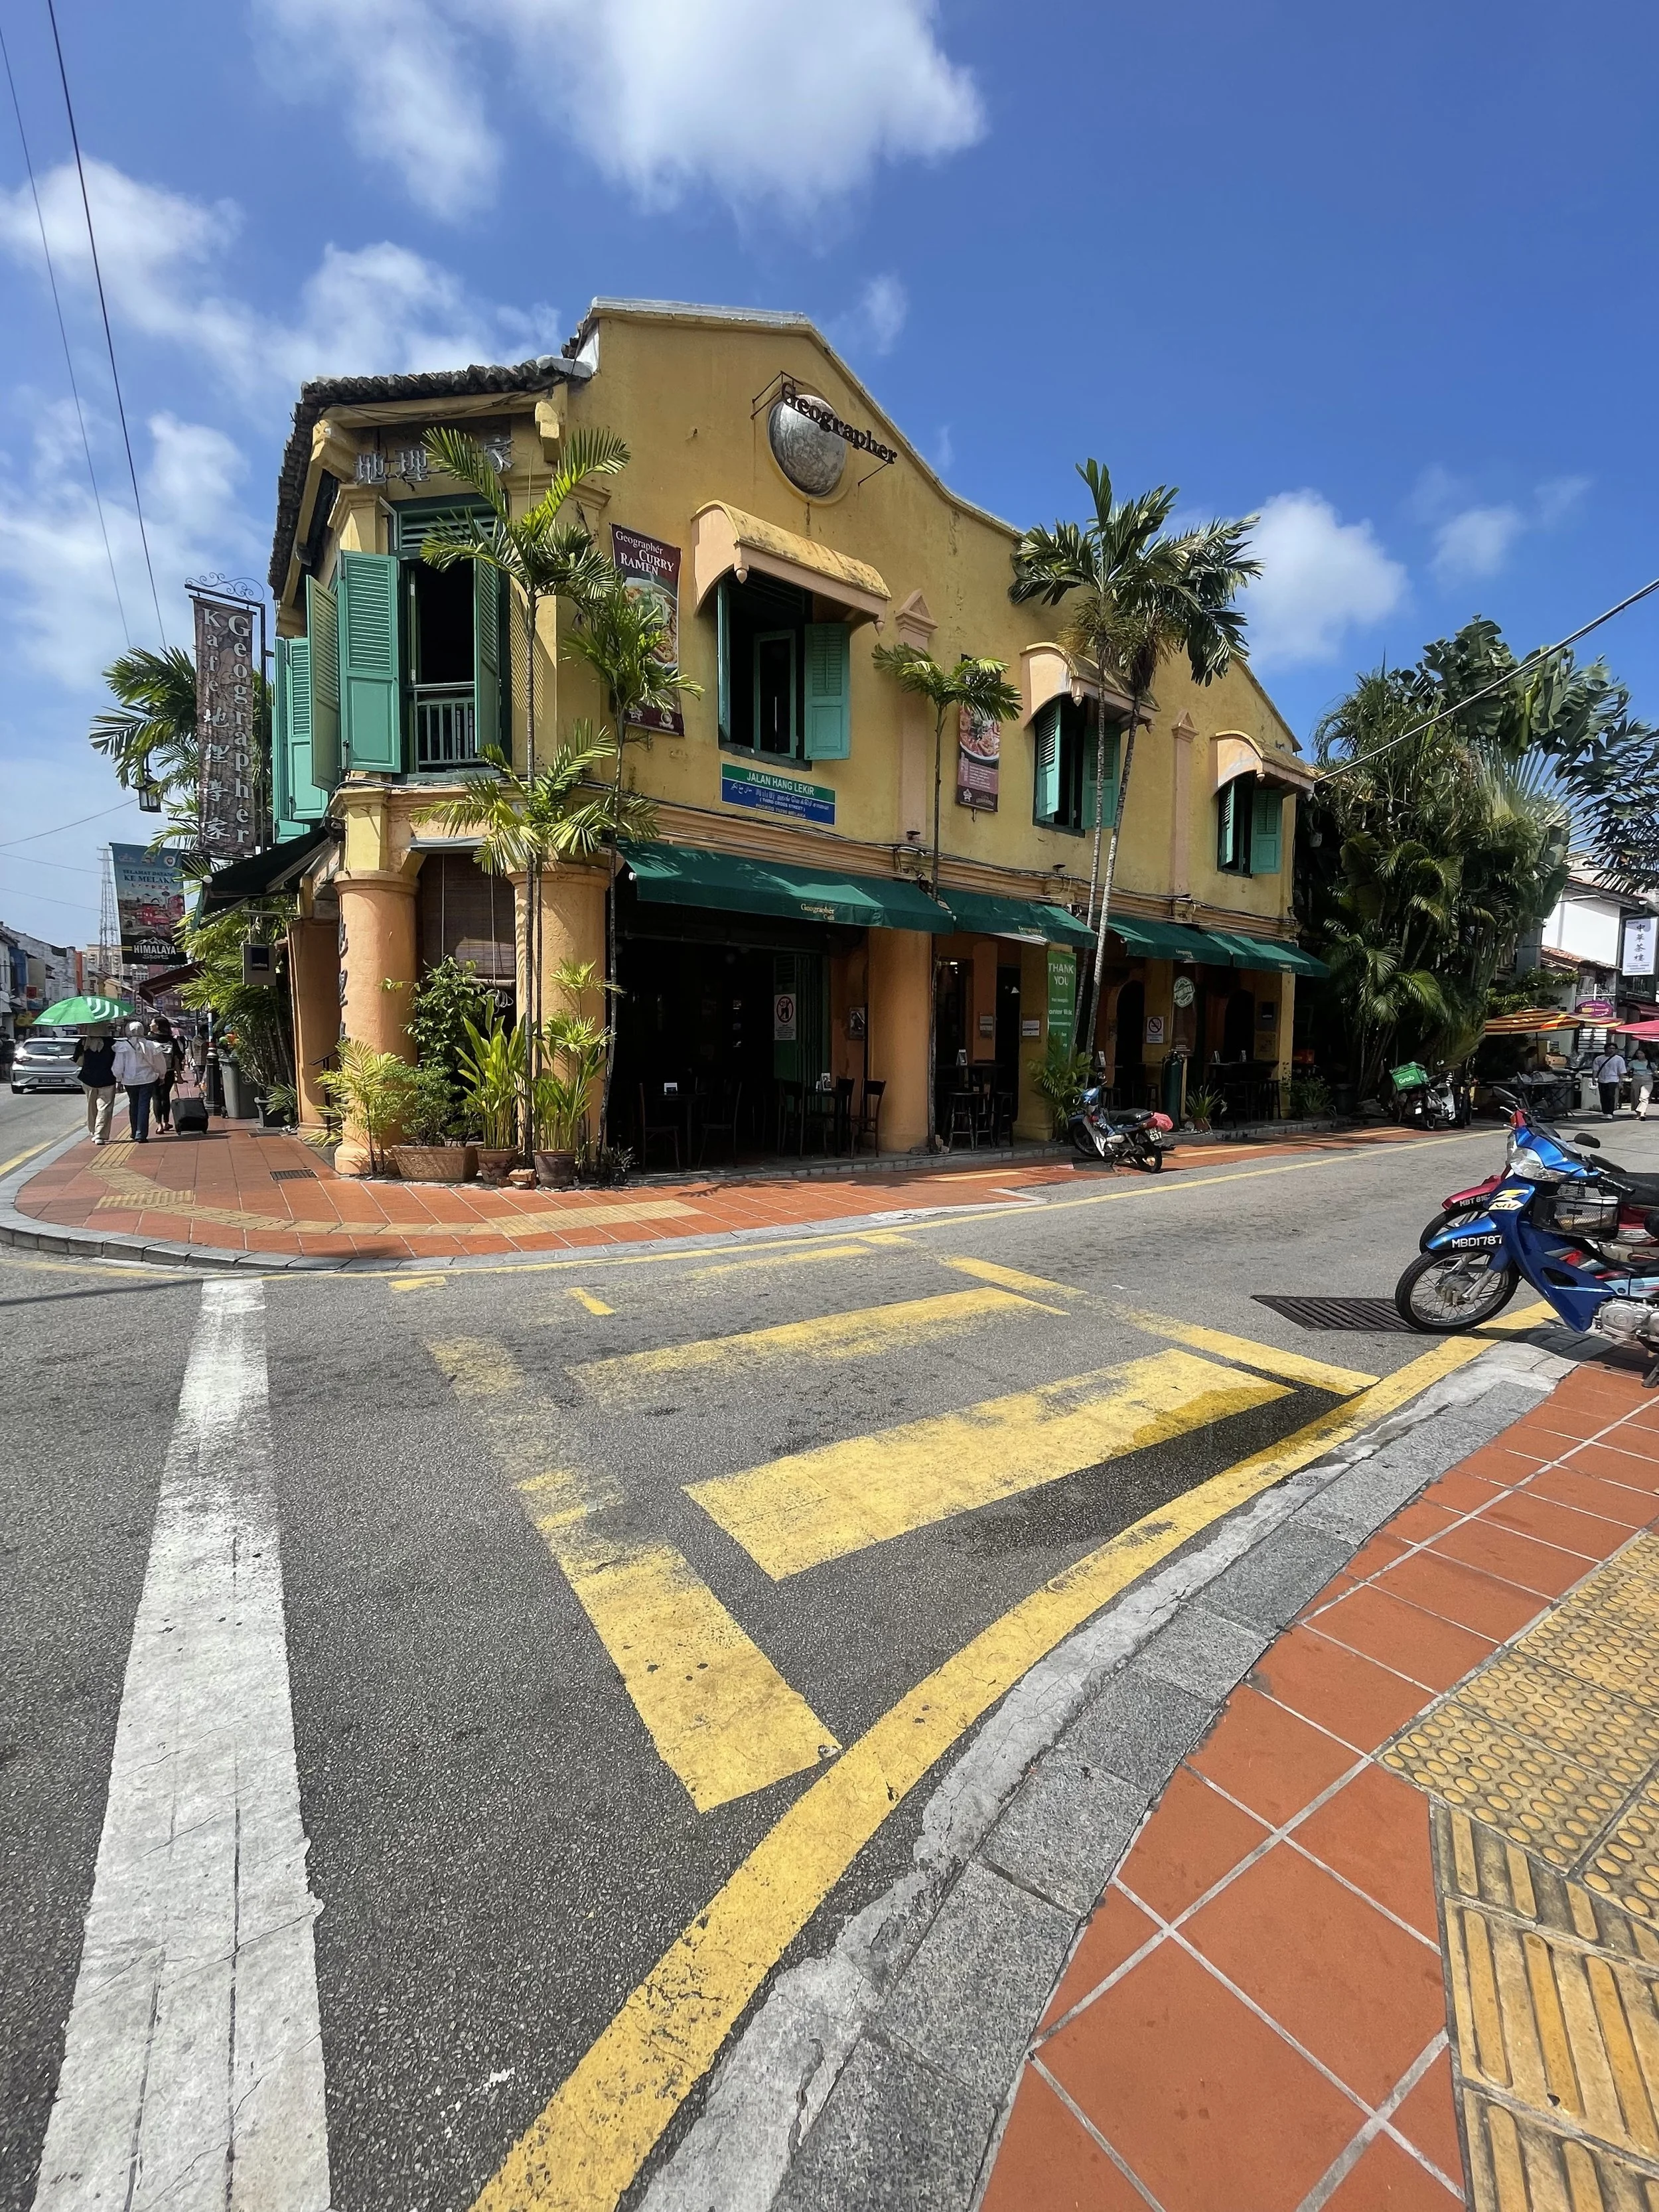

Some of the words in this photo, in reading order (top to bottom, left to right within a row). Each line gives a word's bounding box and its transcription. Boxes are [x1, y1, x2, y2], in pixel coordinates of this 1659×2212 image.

[353, 437, 515, 485] 地理家
[620, 552, 659, 576] RAMEN
[638, 550, 675, 572] CURRY
[202, 607, 222, 692] Kafe
[747, 772, 770, 785] JALAN
[772, 778, 793, 790] HANG
[794, 782, 814, 796] LEKIR
[133, 945, 176, 954] HIMALAYA
[1048, 963, 1074, 974] THANK
[1054, 976, 1069, 986] YOU
[1398, 1075, 1415, 1084] Grab
[1149, 1131, 1162, 1142] 637
[1460, 1197, 1475, 1207] MBT
[1451, 1235, 1502, 1248] MBD1787
